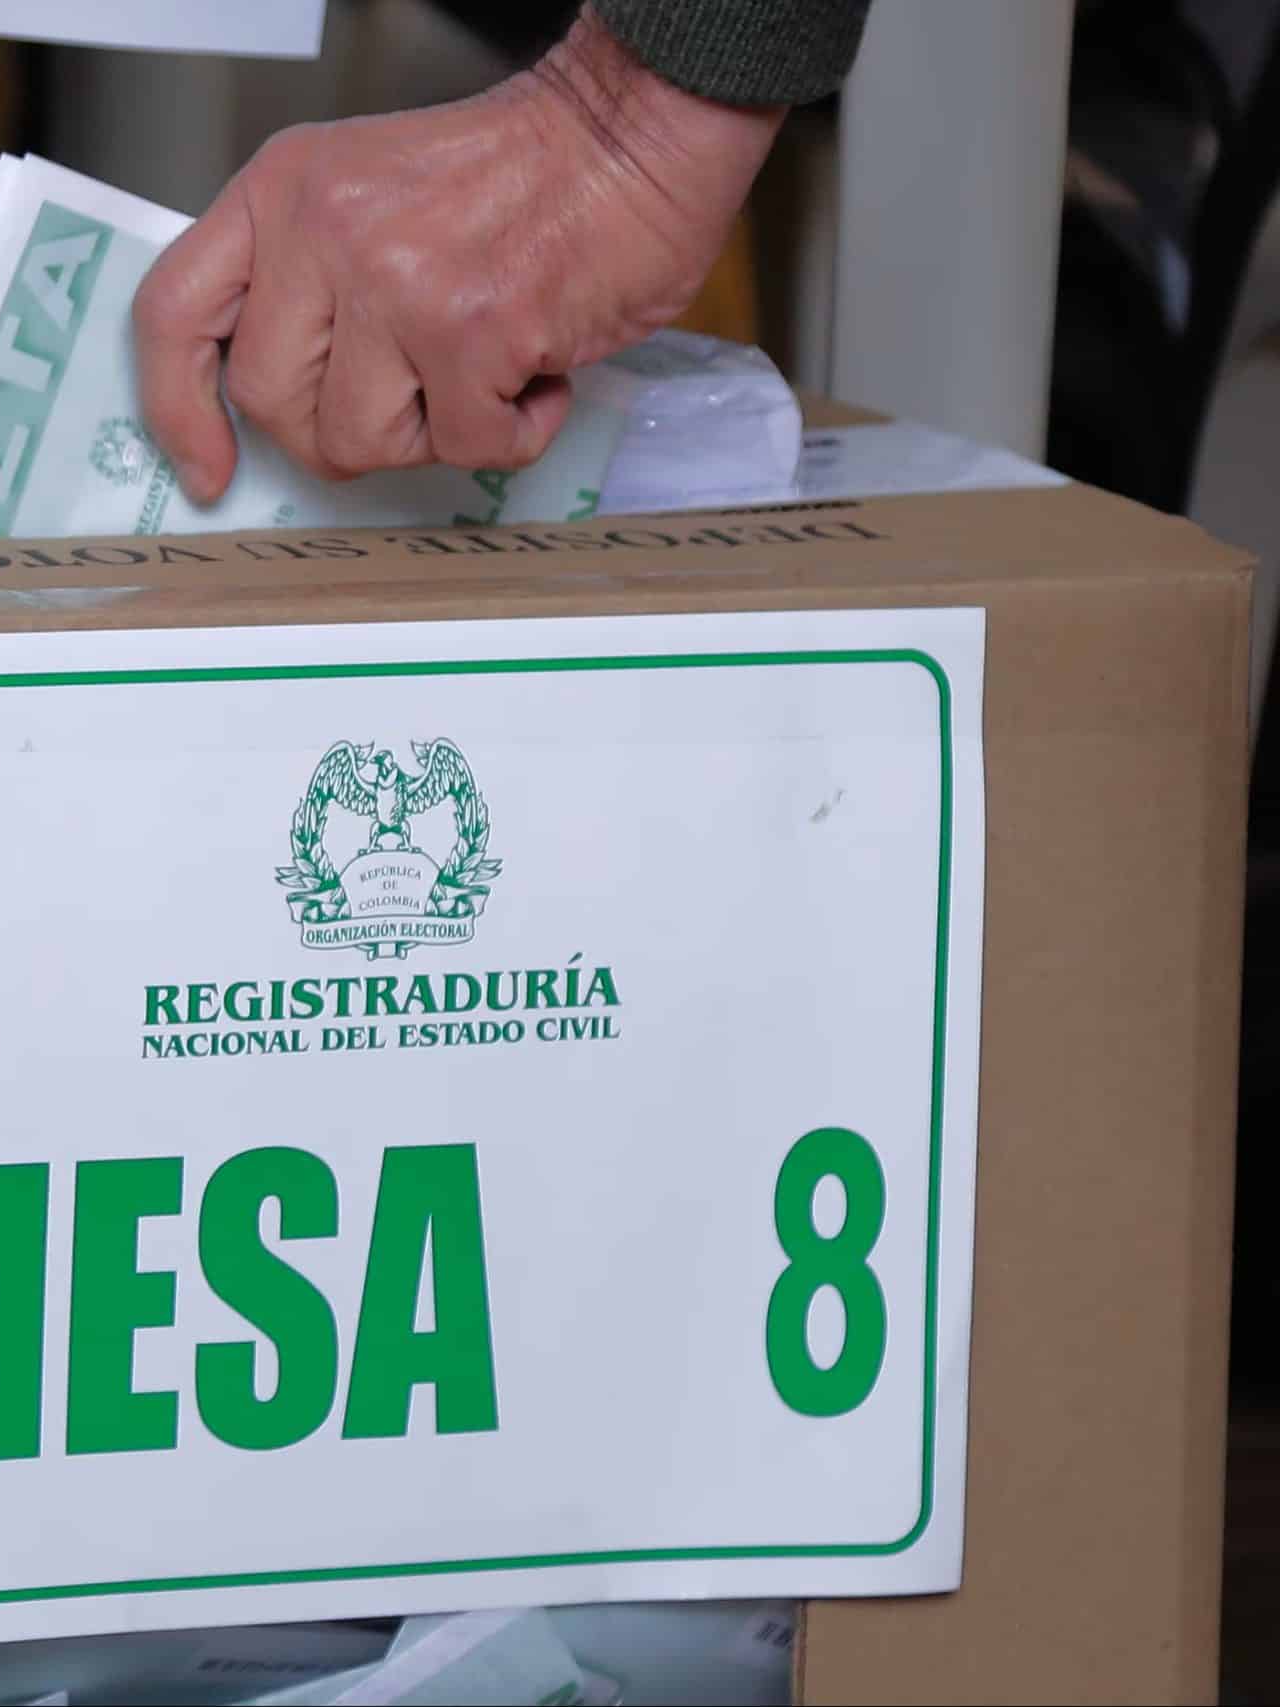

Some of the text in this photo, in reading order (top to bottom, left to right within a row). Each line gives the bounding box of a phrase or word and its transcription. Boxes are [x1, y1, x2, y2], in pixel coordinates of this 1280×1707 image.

[235, 537, 369, 560] SU
[382, 880, 399, 890] DE
[359, 895, 421, 911] COLOMBIA
[305, 919, 470, 944] ORGANIZACIÓN ELECTORAL
[143, 951, 622, 1026] REGISTRADURÍA
[141, 1015, 622, 1059] NACIONAL DEL ESTADO CIVIL
[765, 1126, 887, 1418] 8
